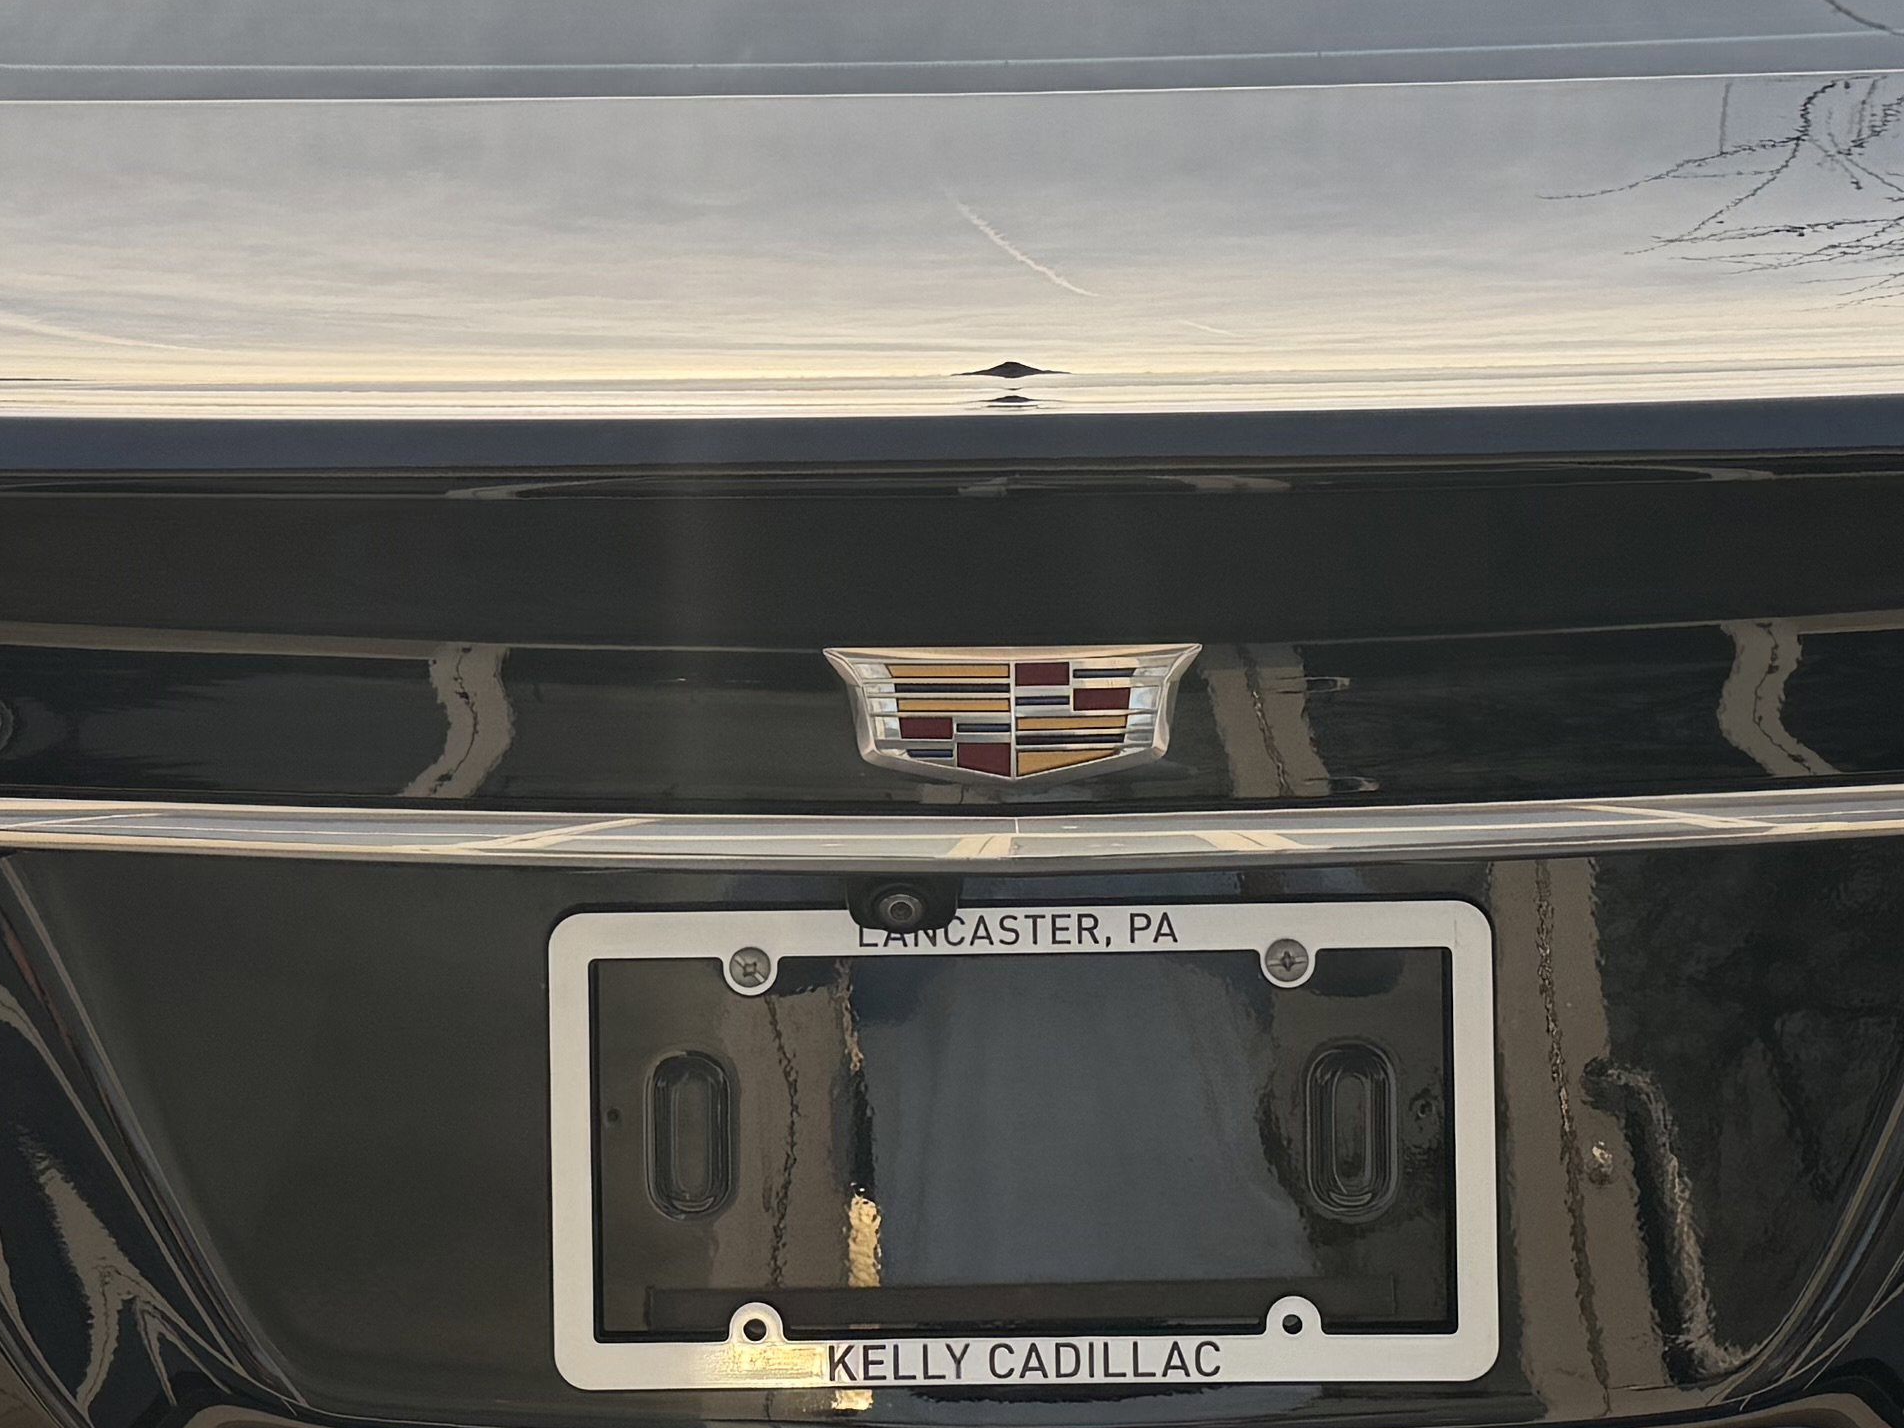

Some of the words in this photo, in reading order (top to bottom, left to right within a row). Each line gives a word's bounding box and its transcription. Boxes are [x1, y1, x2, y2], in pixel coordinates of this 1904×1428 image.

[1128, 911, 1179, 944] PA
[828, 1343, 971, 1381] KELLY
[989, 1340, 1222, 1379] CADILLAC
